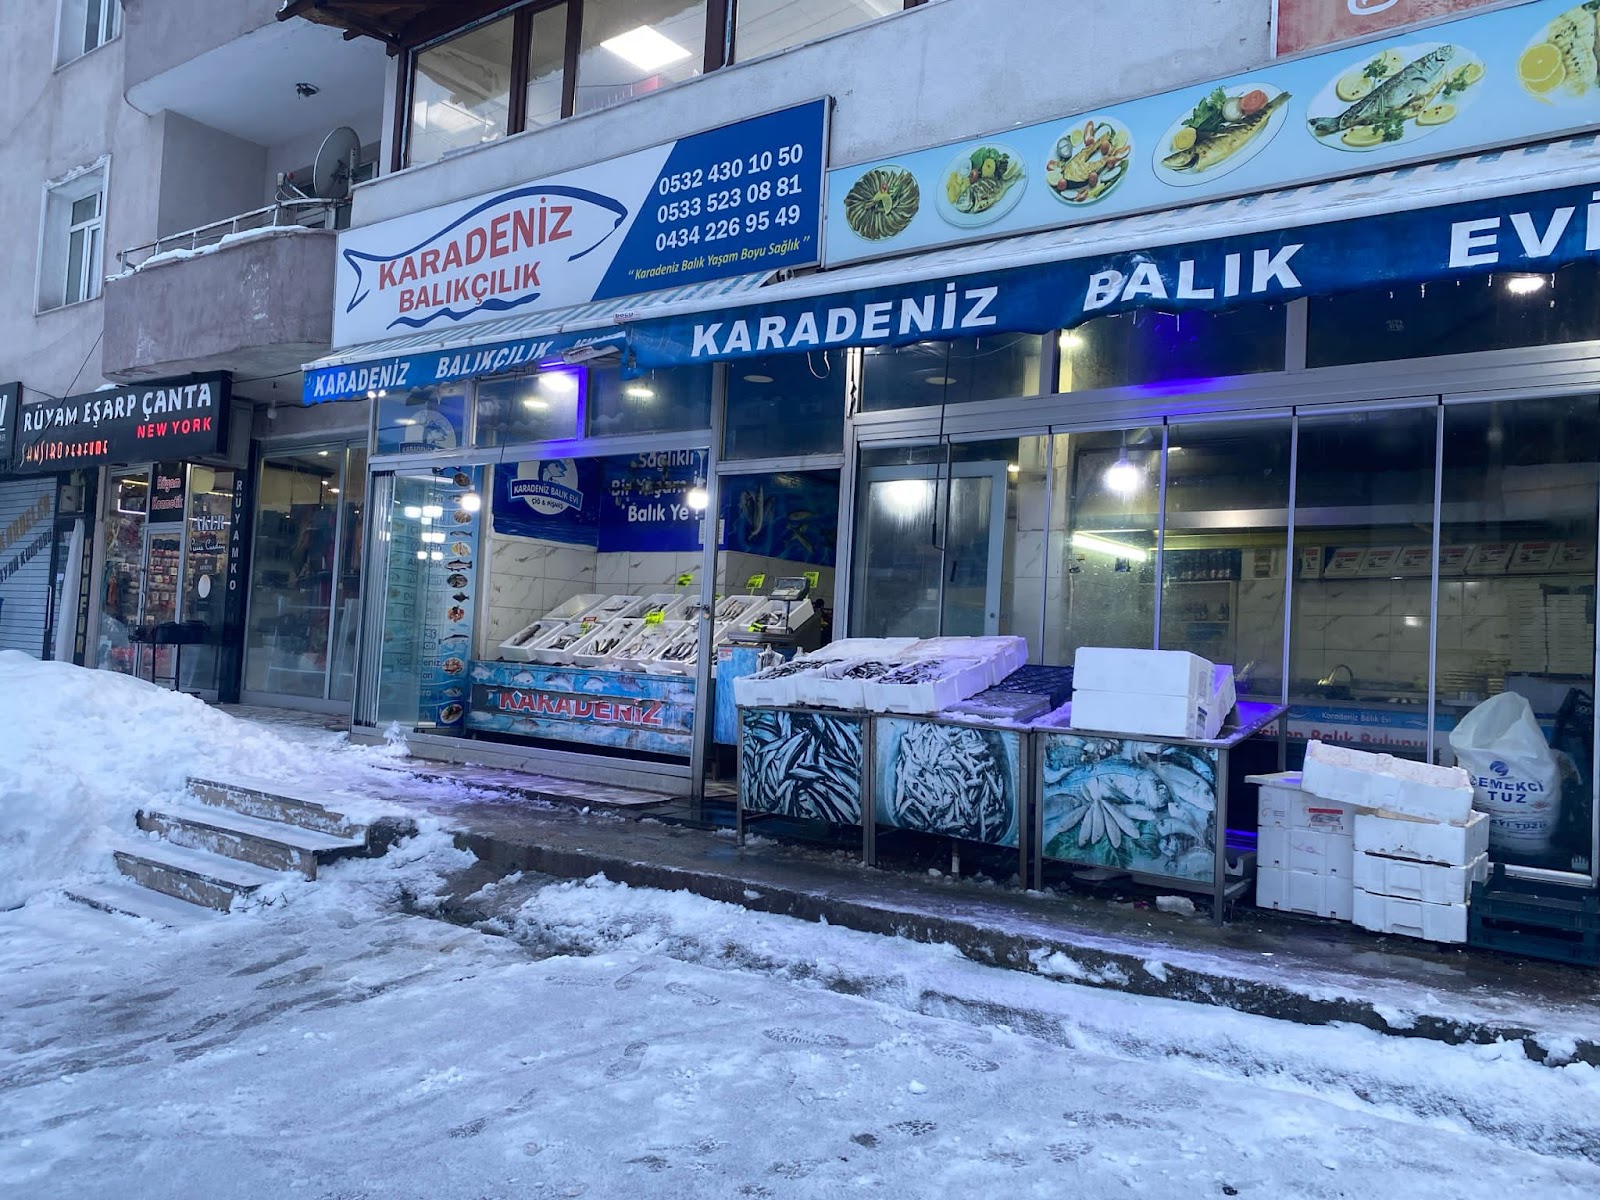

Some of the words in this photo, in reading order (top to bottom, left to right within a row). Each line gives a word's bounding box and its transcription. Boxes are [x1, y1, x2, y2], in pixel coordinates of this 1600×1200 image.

[659, 168, 703, 195] 0532
[707, 158, 743, 183] 430
[747, 151, 772, 174] 10
[778, 144, 803, 167] 50
[657, 196, 701, 223] 0533
[706, 188, 741, 213] 523
[747, 181, 771, 204] 08
[776, 174, 802, 197] 81
[379, 196, 573, 290] KARADENİZ
[655, 225, 700, 251] 0434
[705, 217, 740, 242] 226
[745, 211, 770, 233] 95
[775, 204, 800, 227] 49
[681, 256, 705, 271] Balık
[707, 252, 738, 268] Yaşam
[741, 247, 766, 261] Boyu
[1083, 243, 1304, 312] BALIK
[399, 261, 541, 312] BALIKÇILIK
[690, 281, 999, 358] KARADENİZ
[313, 358, 411, 397] KARADENİZ
[435, 340, 554, 379] BALIKÇILIK
[23, 403, 79, 432] RÜYAM
[83, 394, 137, 428] EŞARP
[142, 383, 212, 421] ÇANTA
[136, 422, 168, 439] NEW
[172, 417, 212, 435] YORK
[514, 483, 550, 495] KARADENİZ
[550, 487, 569, 500] BALIK
[628, 503, 665, 522] Balık
[670, 503, 689, 520] Ye
[499, 690, 662, 726] KARADENİZ
[1321, 711, 1359, 721] Karadeniz
[1360, 713, 1379, 723] Balık
[1380, 716, 1392, 724] Evi
[1487, 790, 1527, 804] TUZ
